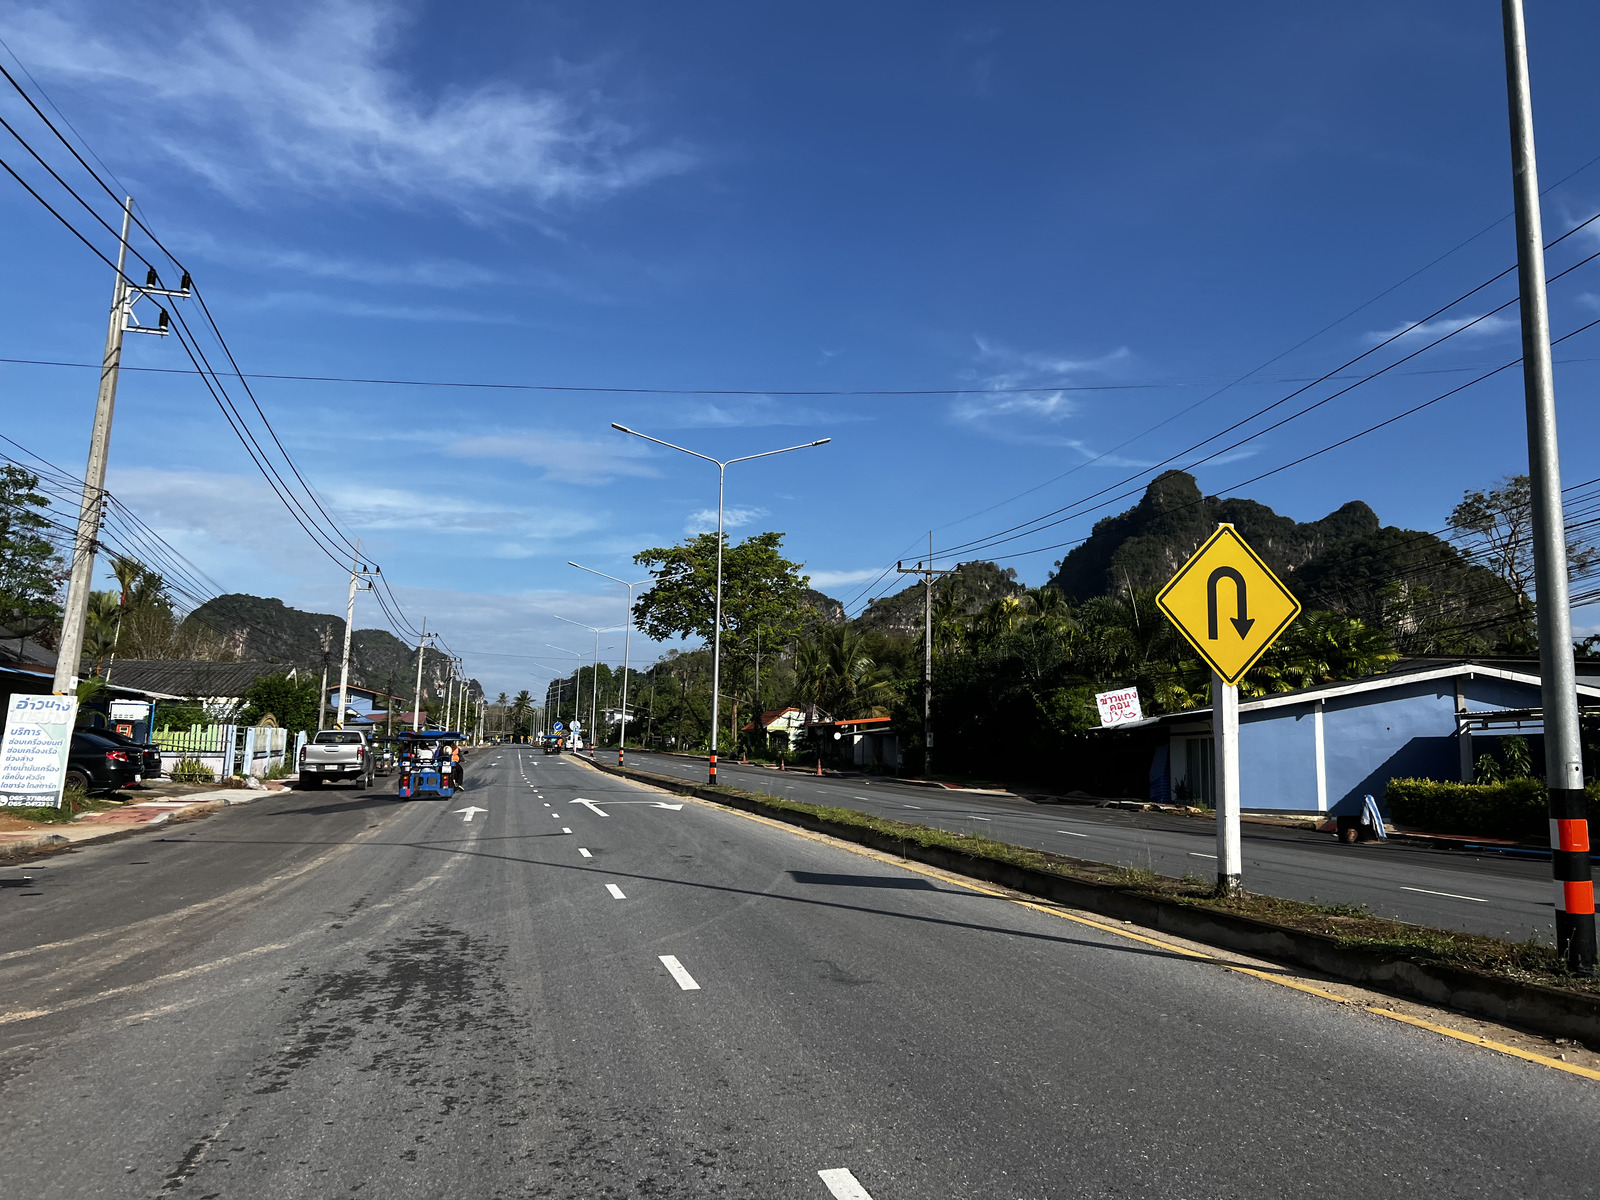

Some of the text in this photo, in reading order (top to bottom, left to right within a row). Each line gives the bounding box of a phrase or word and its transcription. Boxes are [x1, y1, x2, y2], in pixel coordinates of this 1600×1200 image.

[1099, 692, 1137, 705] ข้าวแกง
[16, 697, 71, 711] อ่าวนาง
[1109, 701, 1131, 711] คอน
[10, 728, 42, 736] บริการ
[8, 738, 64, 746] ซ่อมเครื่องยนต์
[7, 746, 58, 754] ซ่อมเครื่องเรือ
[3, 763, 60, 772] ถ่ายน้ำมันเครื่อง
